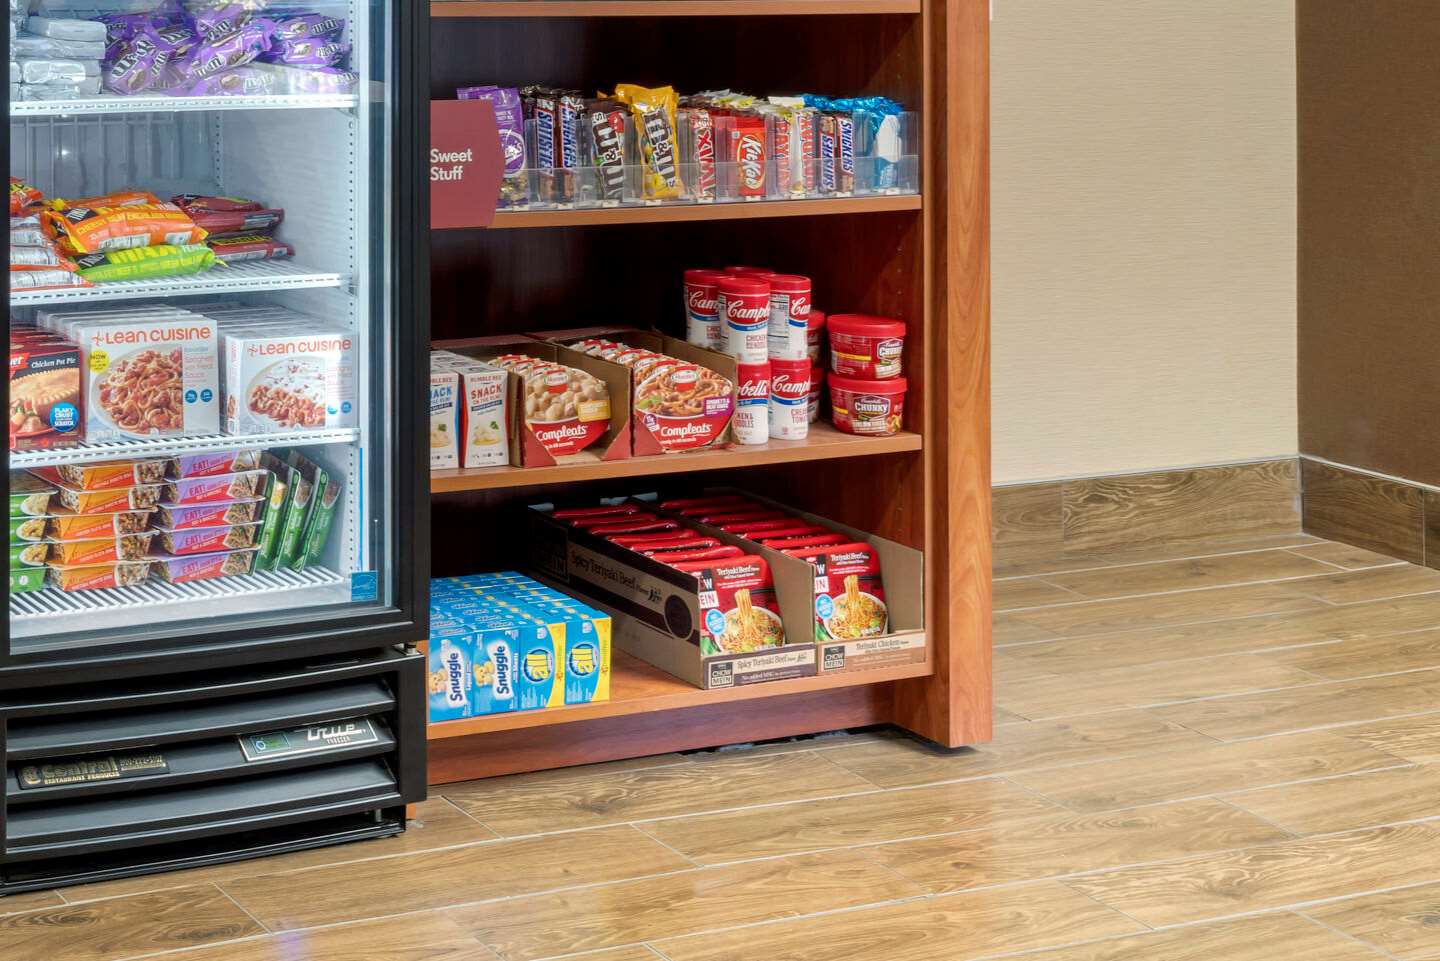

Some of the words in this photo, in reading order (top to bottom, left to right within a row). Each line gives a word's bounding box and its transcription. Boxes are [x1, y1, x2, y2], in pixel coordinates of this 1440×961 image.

[742, 135, 762, 161] Kit
[841, 119, 853, 174] SNICKERS
[430, 148, 473, 163] Sweet
[430, 166, 464, 181] Stuff
[741, 159, 762, 186] Kat
[105, 328, 148, 345] Lean
[259, 342, 296, 356] Lean
[31, 360, 55, 369] Chicken
[55, 359, 66, 367] Pot
[66, 356, 76, 365] Pie
[470, 383, 502, 400] SNACK
[854, 402, 888, 413] CHUNKY
[536, 425, 587, 442] Compleats
[660, 423, 712, 439] Compleats
[856, 641, 877, 650] Teriyaki
[877, 640, 900, 648] Chicken
[752, 657, 775, 667] Teriyaki
[775, 655, 788, 664] Beef
[825, 653, 844, 661] CHOW
[449, 652, 463, 702] Snuggle
[496, 645, 510, 695] Snuggle
[711, 669, 732, 677] CHOW
[711, 676, 732, 686] MEIN
[306, 724, 361, 741] true
